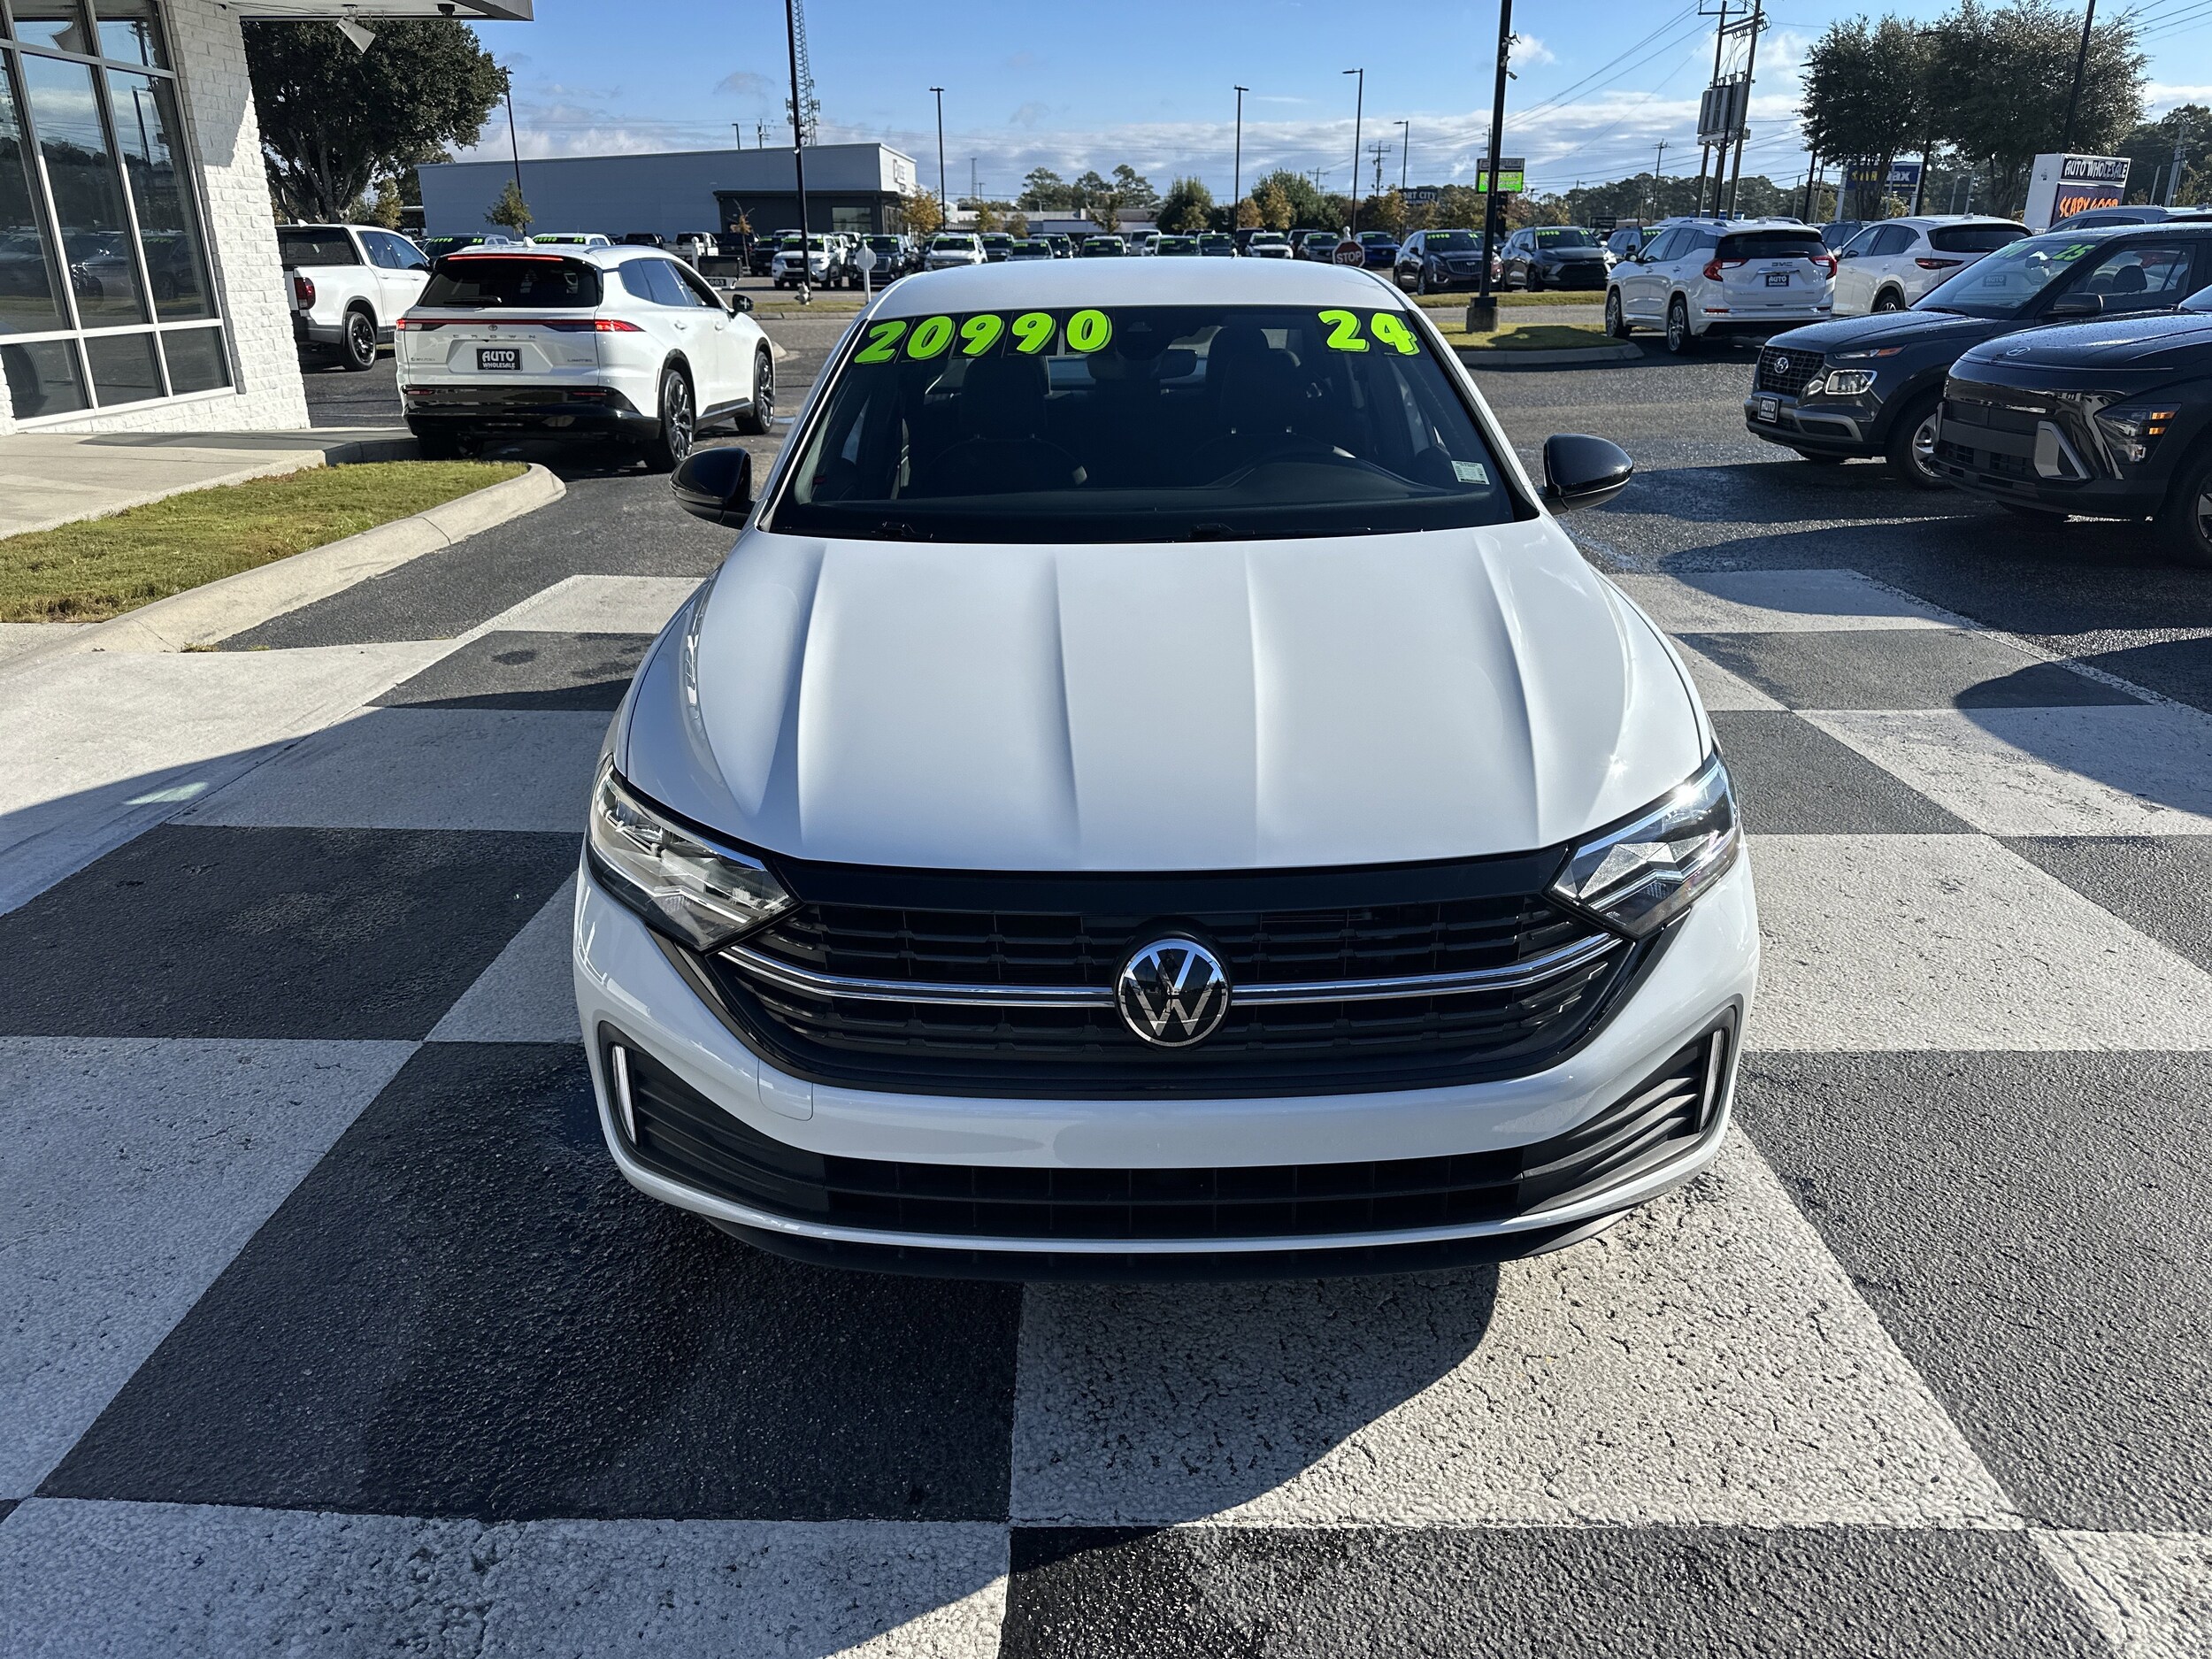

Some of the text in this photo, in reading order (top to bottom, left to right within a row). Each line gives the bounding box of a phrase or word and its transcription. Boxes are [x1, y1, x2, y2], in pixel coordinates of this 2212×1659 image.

[2064, 160, 2127, 180] AUTO WHOLESALE
[1419, 191, 1436, 200] CITY
[1336, 250, 1362, 264] STOP
[2052, 243, 2096, 261] 25
[854, 309, 1420, 364] 20990 24
[481, 350, 515, 362] AUTO
